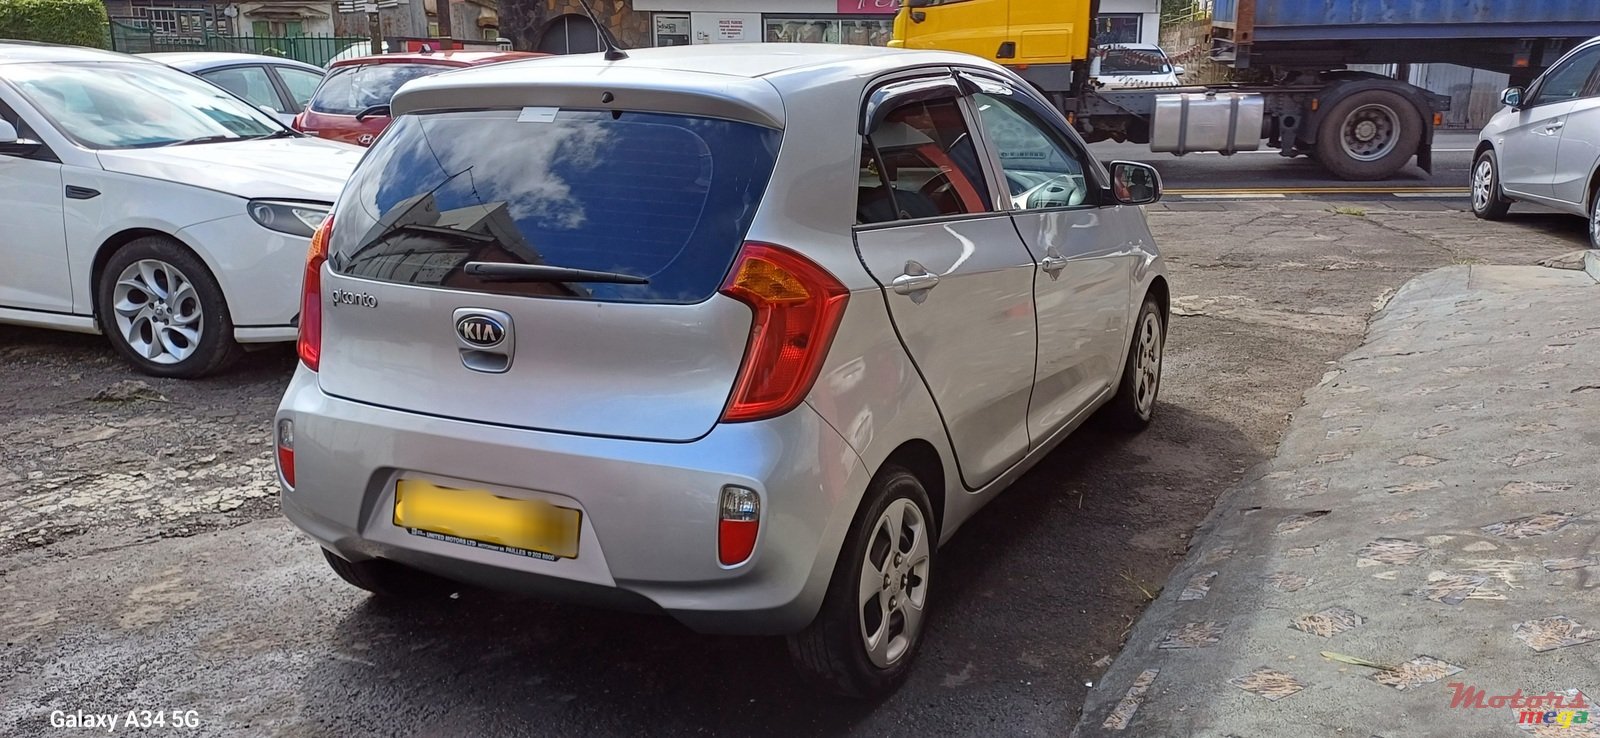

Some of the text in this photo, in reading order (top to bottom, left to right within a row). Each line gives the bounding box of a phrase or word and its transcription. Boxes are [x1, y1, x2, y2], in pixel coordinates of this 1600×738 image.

[332, 288, 378, 309] picanto
[463, 321, 497, 342] KIA
[426, 532, 444, 541] UNITED
[445, 535, 466, 544] MOTORS
